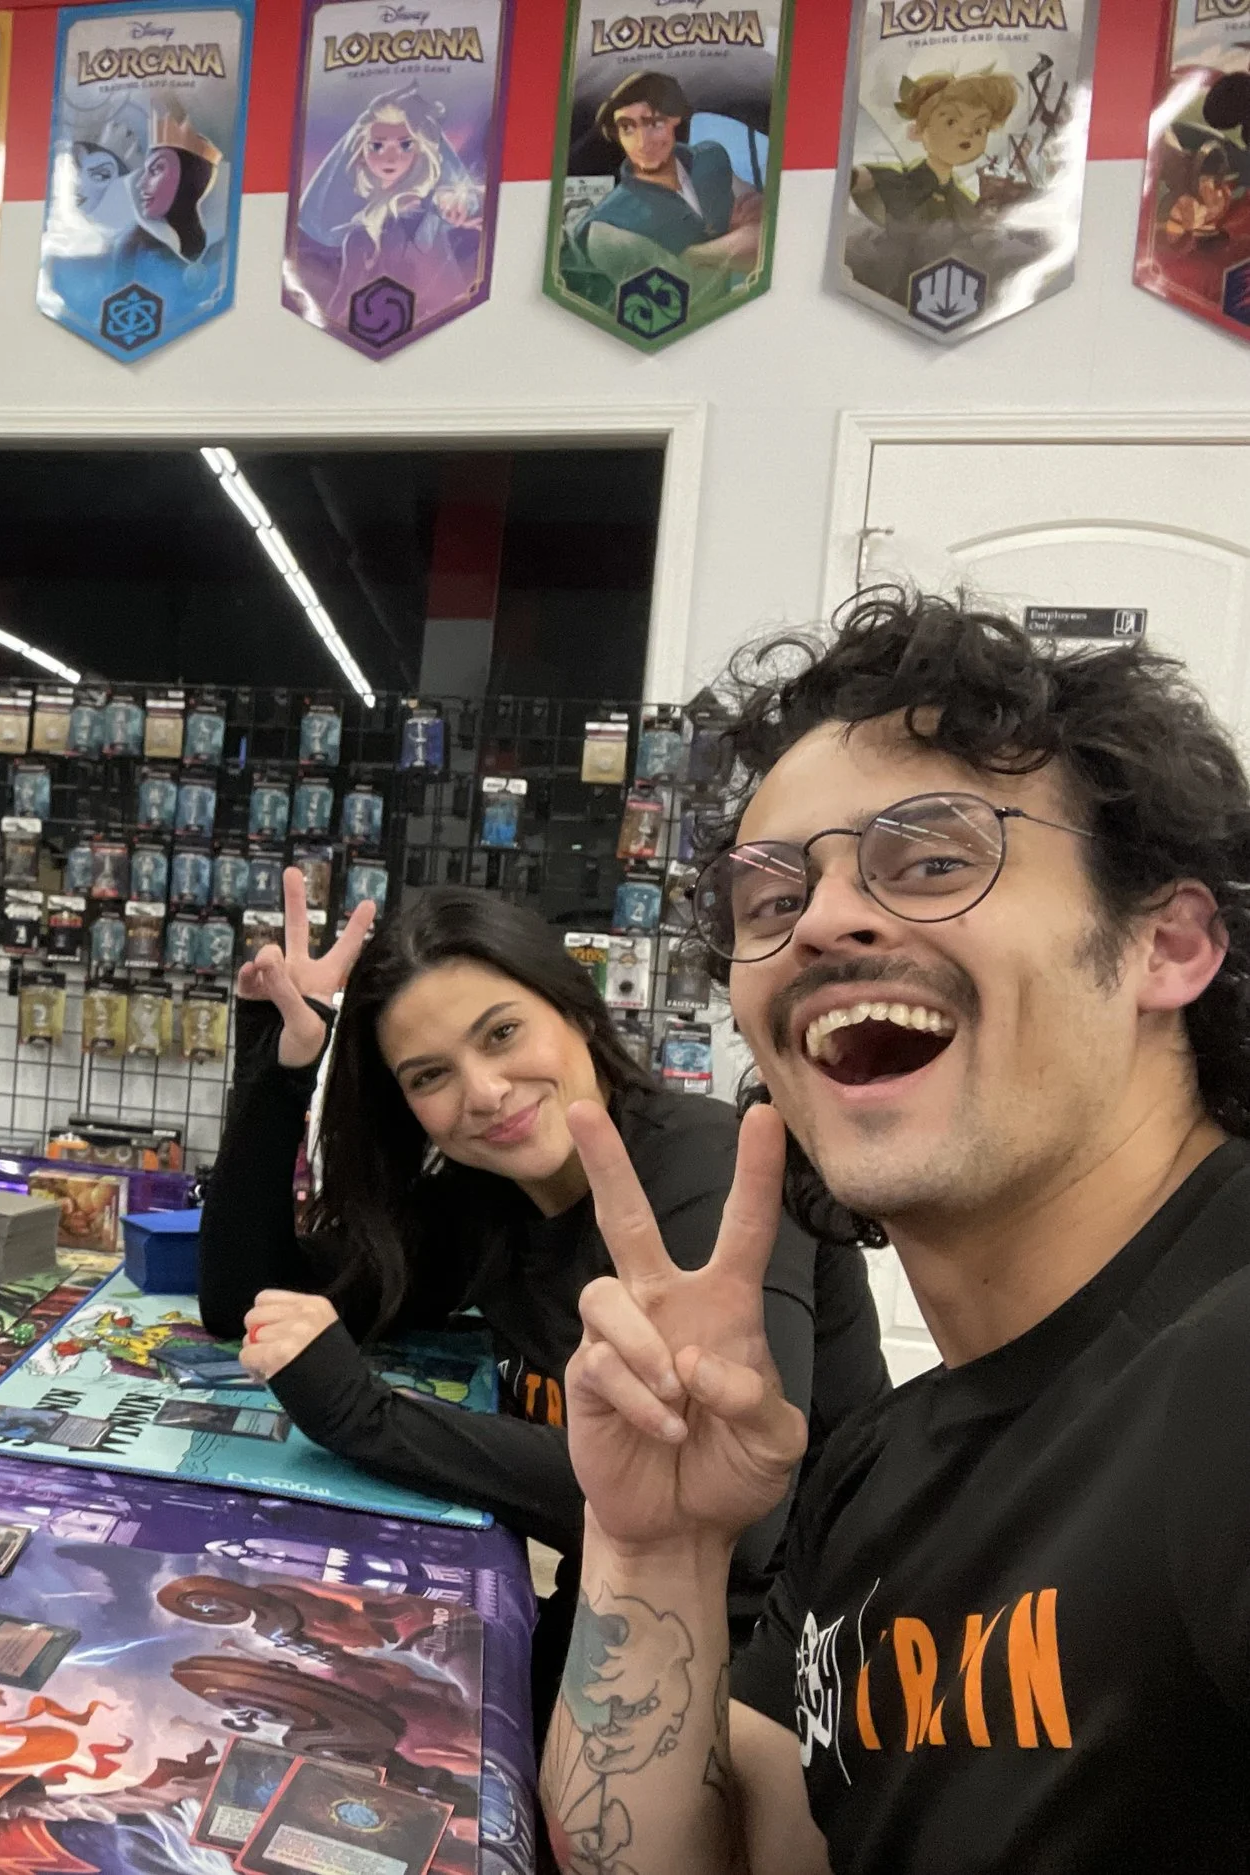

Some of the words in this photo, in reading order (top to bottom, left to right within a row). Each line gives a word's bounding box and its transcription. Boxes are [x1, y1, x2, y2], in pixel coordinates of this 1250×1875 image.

[378, 5, 430, 25] Disney
[880, 0, 1068, 39] LORCANA
[128, 22, 175, 41] Disney
[591, 10, 764, 56] LORCANA
[908, 36, 958, 48] TRADING
[997, 34, 1030, 43] GAME
[324, 27, 484, 71] LORCANA
[78, 43, 226, 85] LORCANA
[1030, 609, 1087, 621] Employees
[1029, 622, 1055, 632] Only
